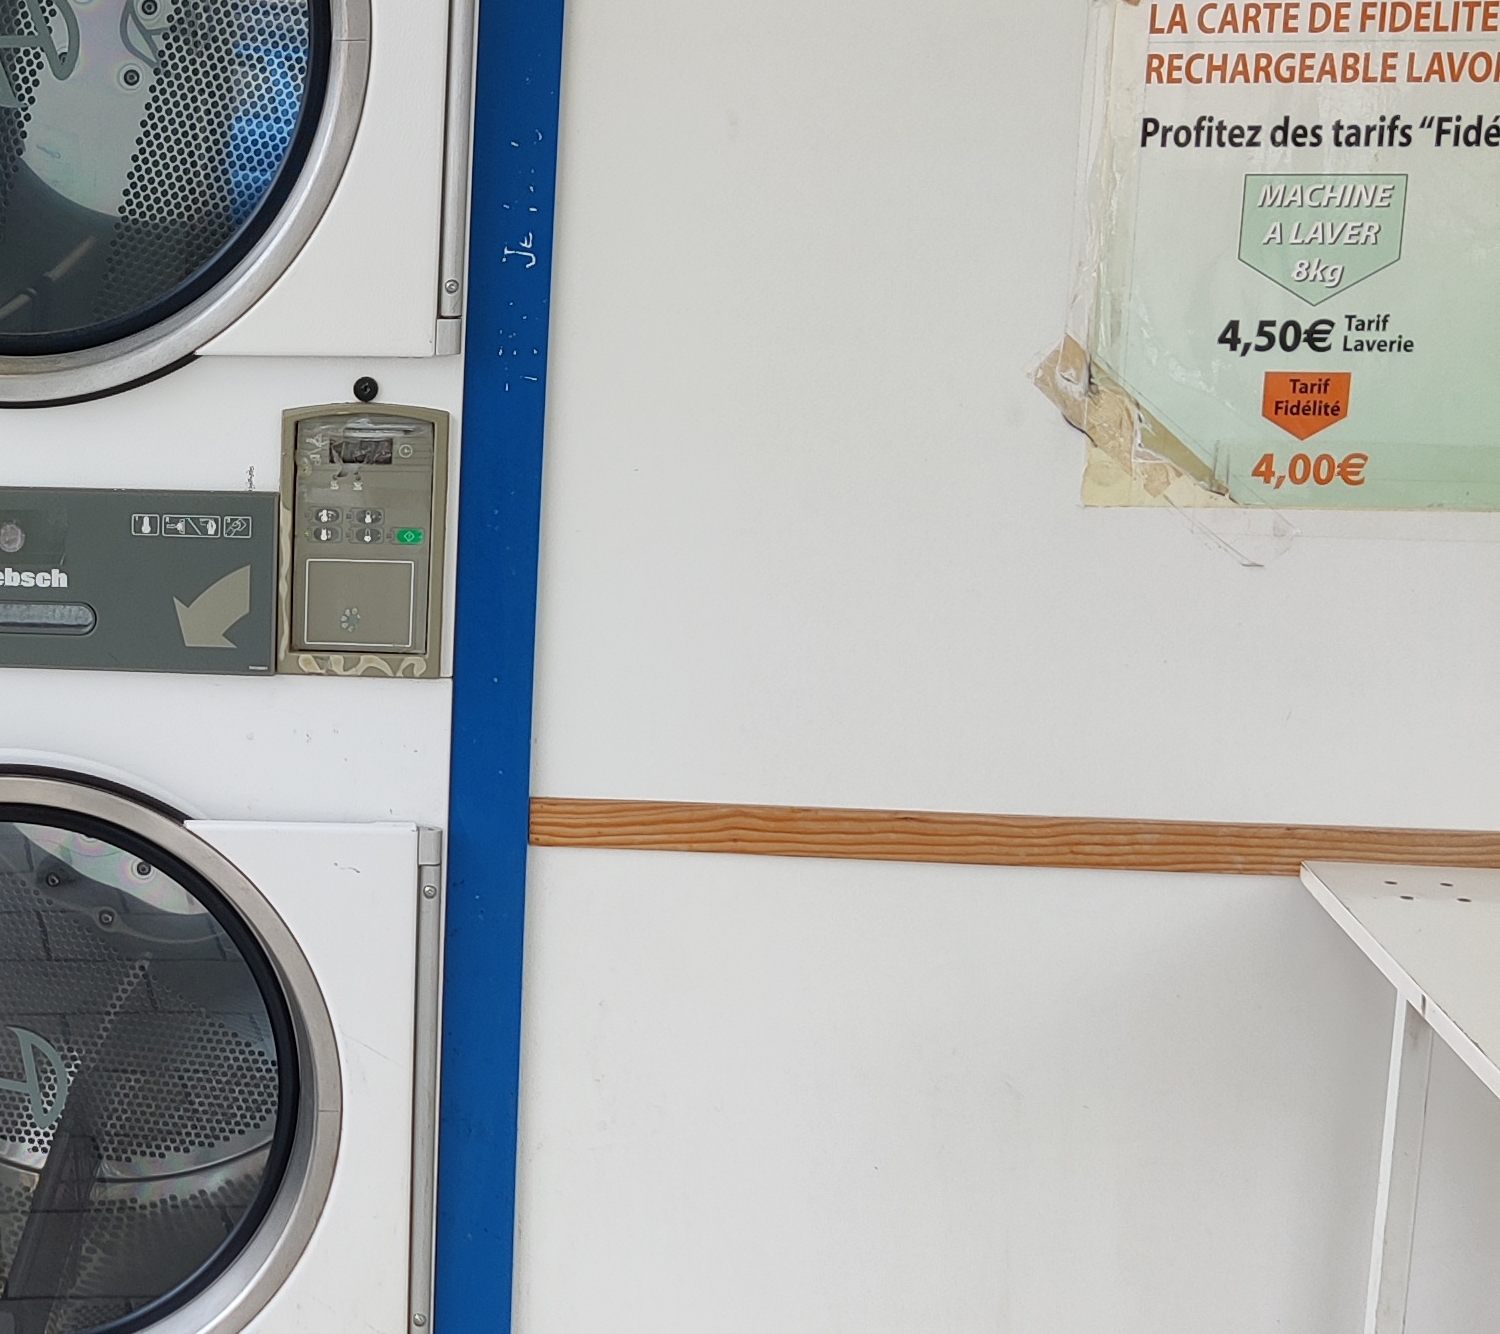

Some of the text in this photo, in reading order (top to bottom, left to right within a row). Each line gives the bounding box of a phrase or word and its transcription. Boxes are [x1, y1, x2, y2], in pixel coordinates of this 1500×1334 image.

[1149, 3, 1188, 34] LA
[1197, 2, 1301, 34] CARTE
[1308, 2, 1351, 34] DE
[1145, 52, 1399, 84] RECHARGEABLE
[1140, 116, 1262, 148] Profitez
[1270, 116, 1323, 147] des
[1332, 115, 1413, 147] tarifs
[1257, 183, 1395, 209] MACHINE
[1262, 221, 1382, 245] A LAVER
[1290, 258, 1345, 288] 8kg
[1345, 314, 1391, 331] Tarif
[1217, 319, 1336, 357] 4,50€
[1343, 334, 1414, 353] Laverie
[1289, 378, 1330, 394] Tarif
[1274, 400, 1341, 416] Fidélité
[1251, 452, 1369, 490] 4,00€
